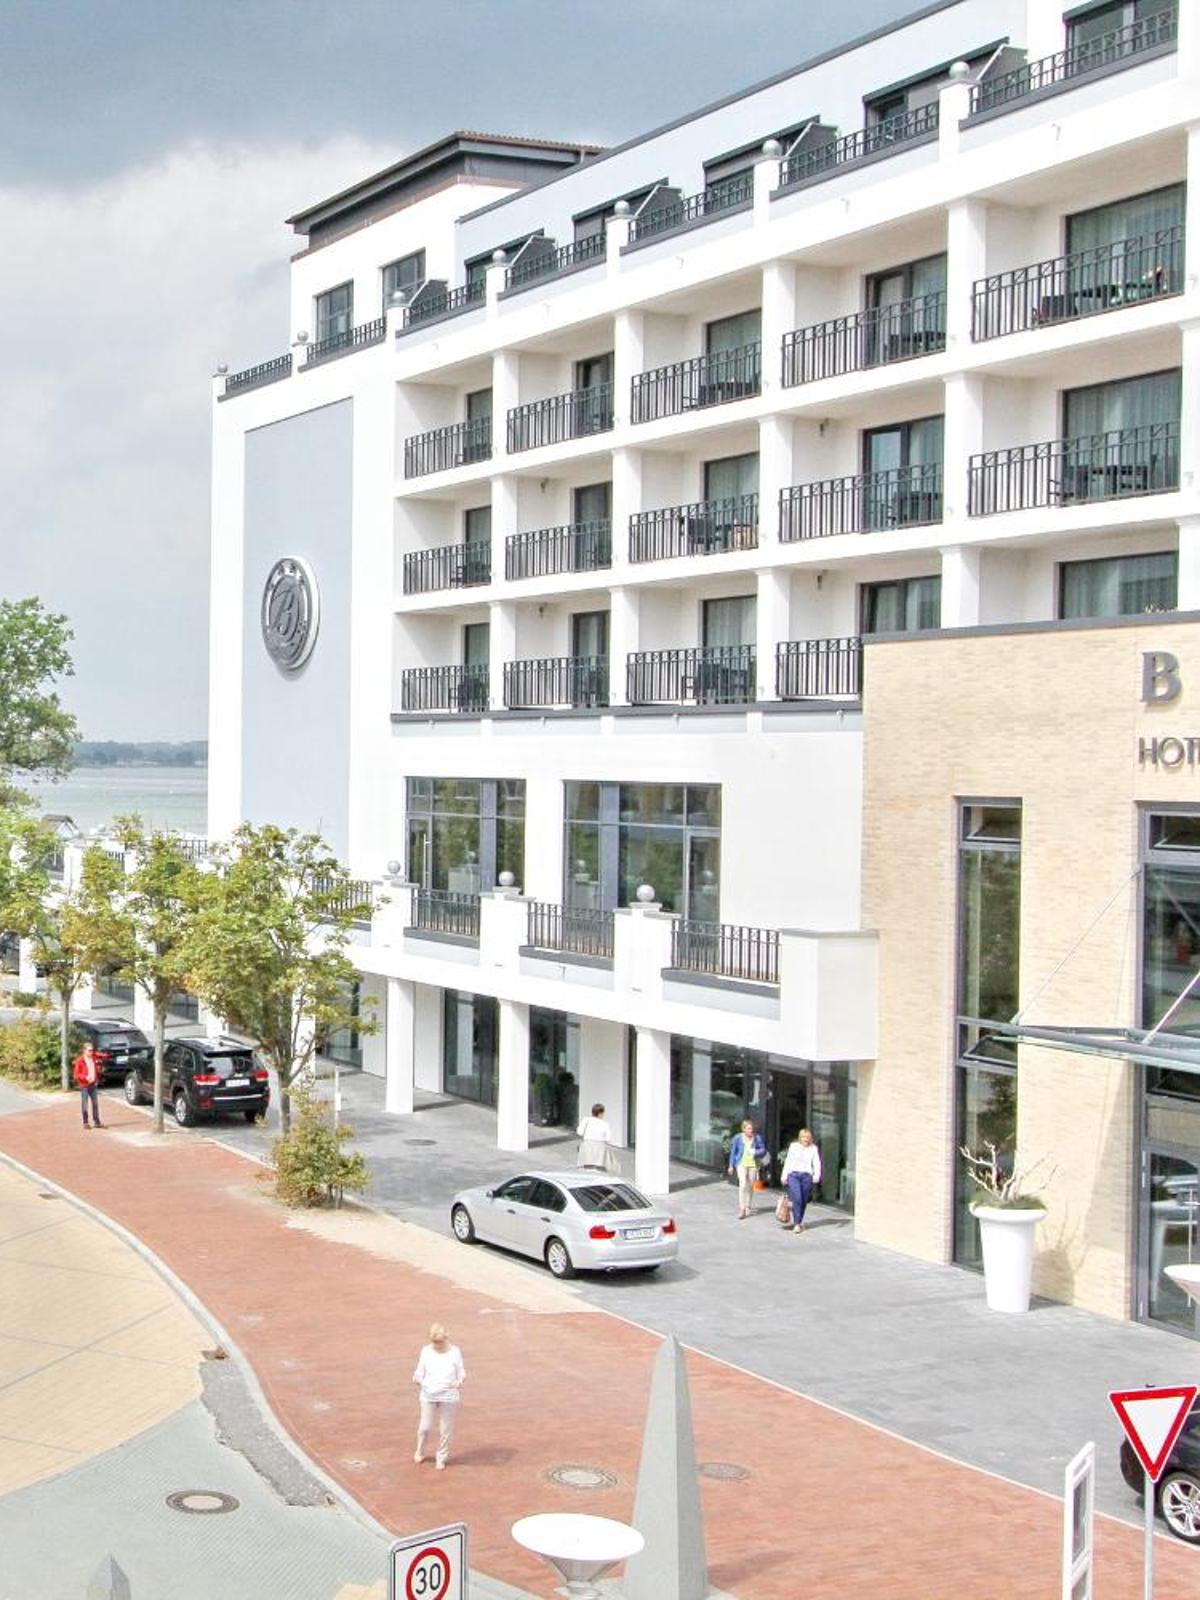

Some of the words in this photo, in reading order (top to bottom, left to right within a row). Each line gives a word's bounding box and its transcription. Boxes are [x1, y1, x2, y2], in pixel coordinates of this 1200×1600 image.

[1140, 651, 1182, 702] B
[1138, 737, 1200, 764] HOT
[415, 1563, 441, 1595] 30
